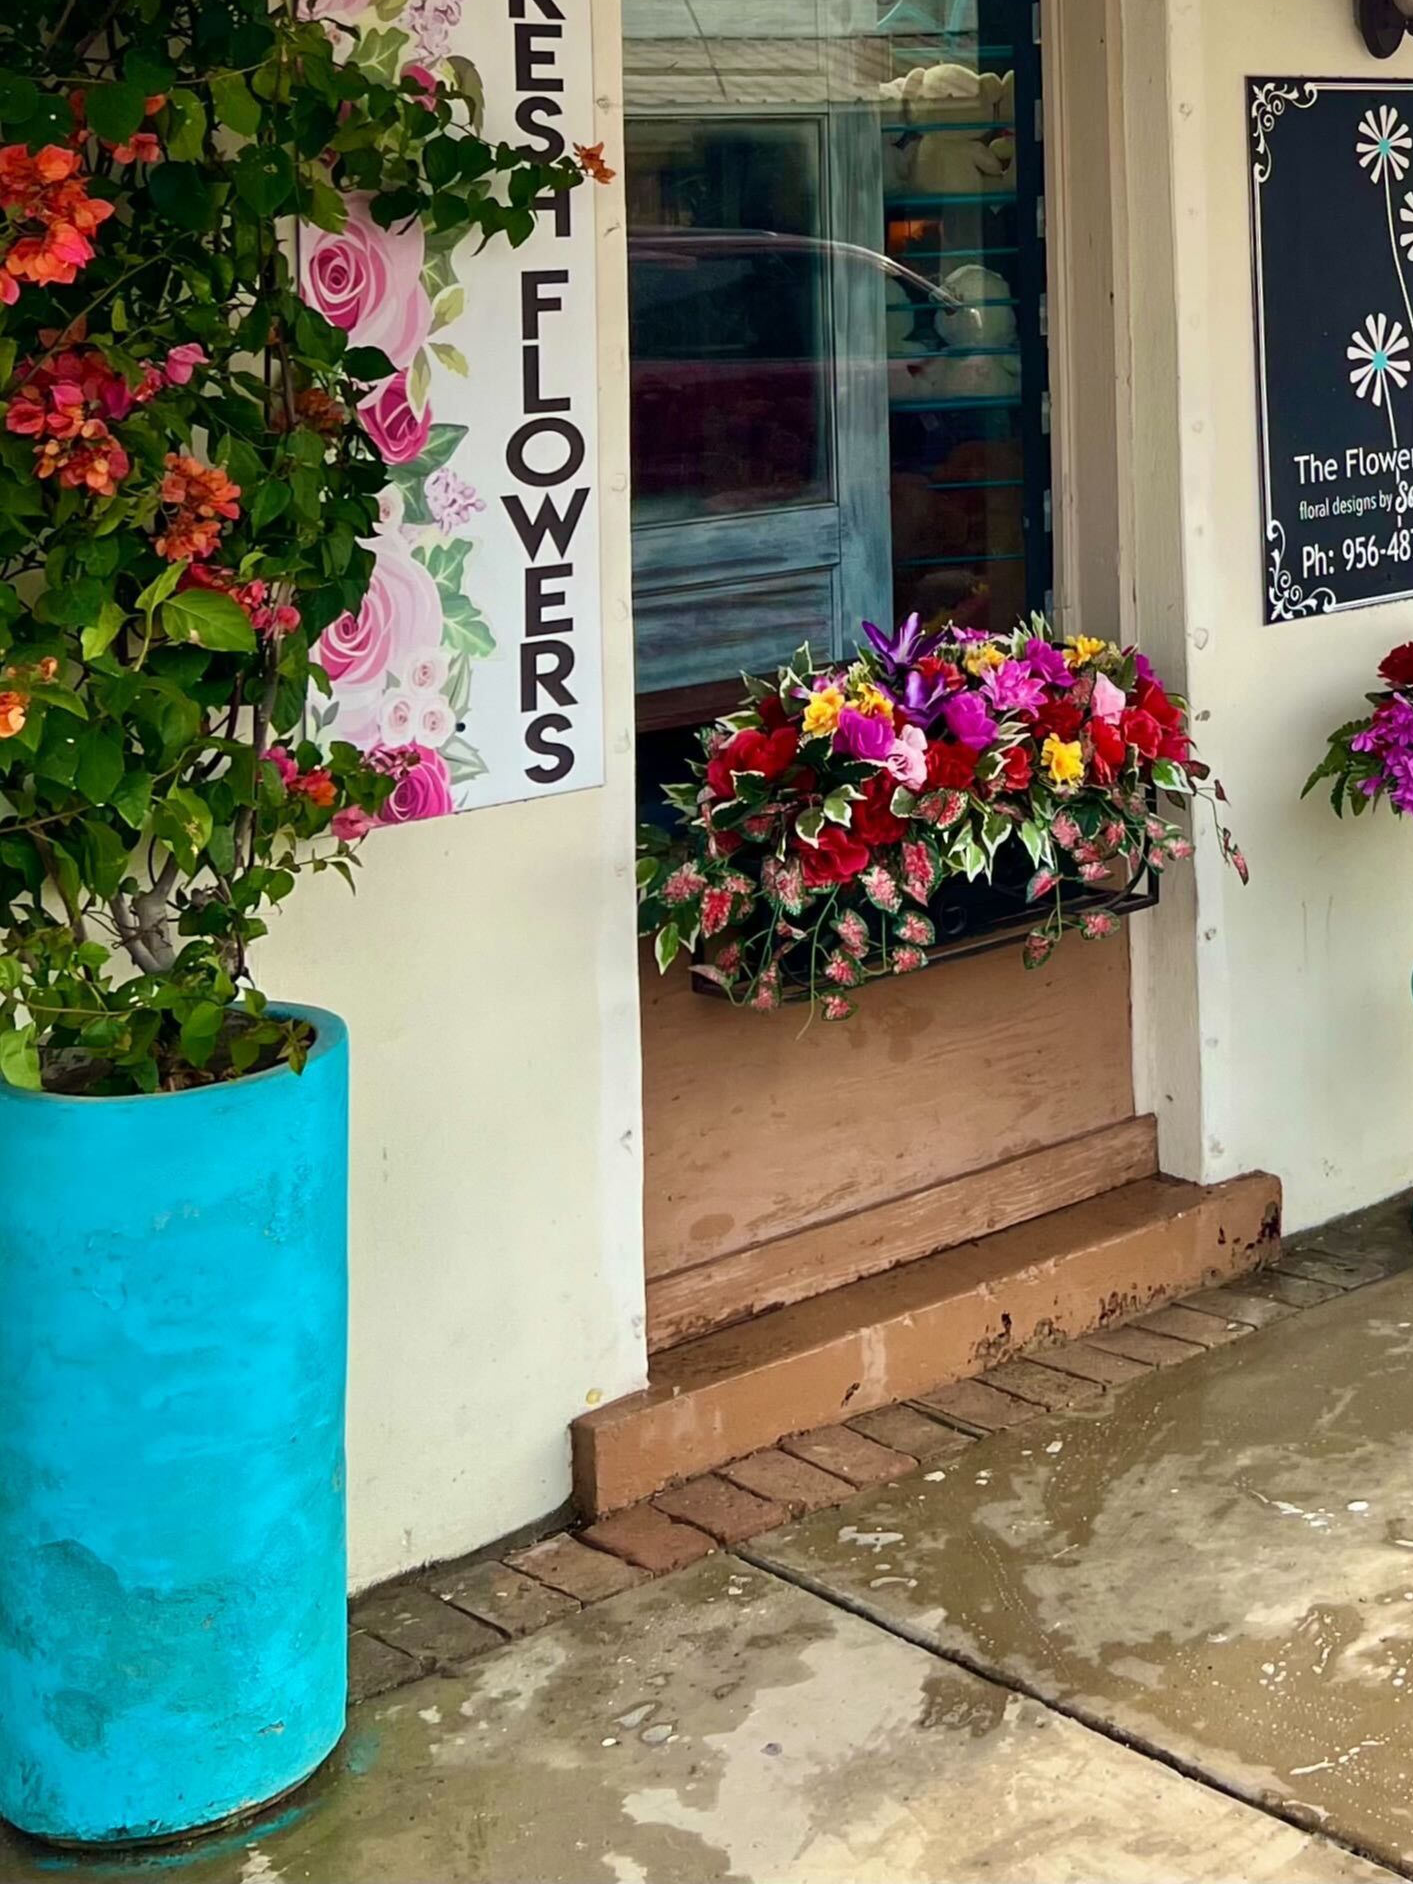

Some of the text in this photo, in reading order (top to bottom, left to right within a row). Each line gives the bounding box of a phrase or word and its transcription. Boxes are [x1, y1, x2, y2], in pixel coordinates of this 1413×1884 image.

[1293, 453, 1338, 485] The
[1298, 497, 1330, 521] floral
[1331, 494, 1378, 517] designs
[1379, 489, 1394, 513] by
[501, 266, 590, 785] FLOWERS
[1302, 543, 1336, 580] Ph:
